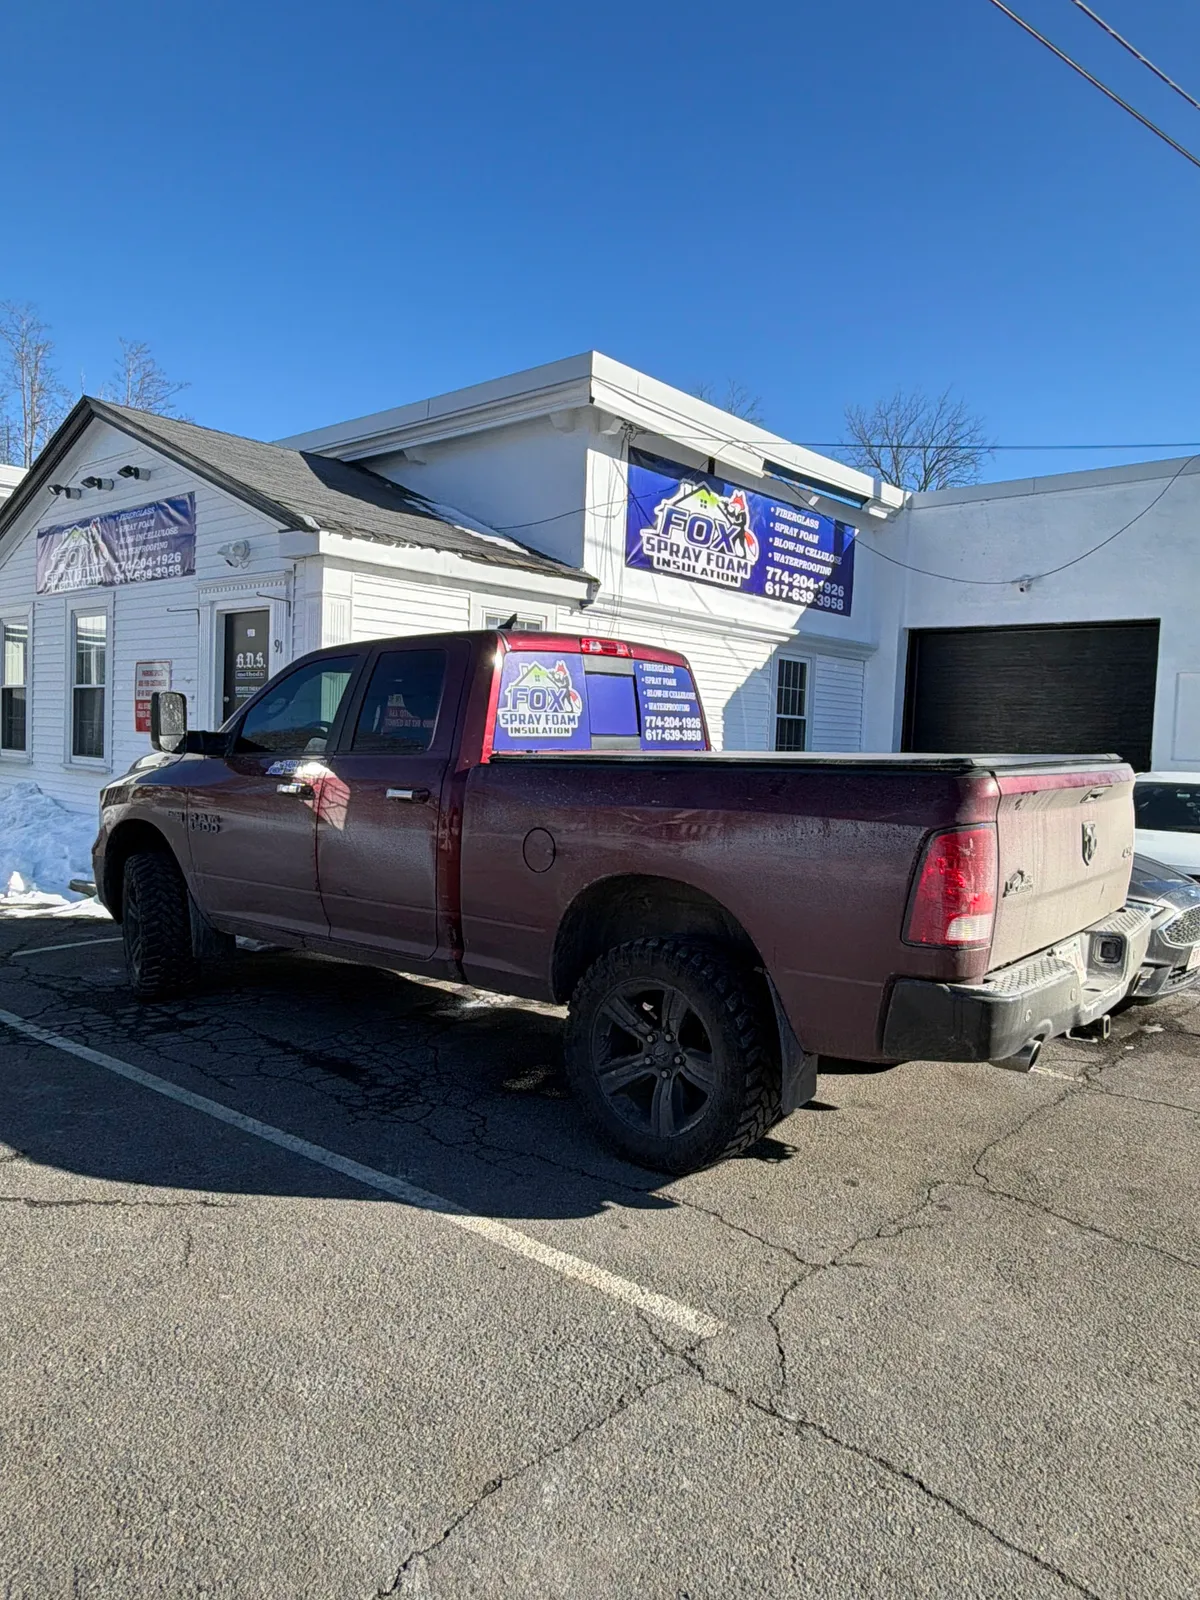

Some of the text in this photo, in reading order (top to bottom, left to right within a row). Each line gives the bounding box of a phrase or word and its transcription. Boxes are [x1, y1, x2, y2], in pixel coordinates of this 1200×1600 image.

[775, 507, 819, 529] FIBERGLASS
[660, 505, 741, 556] FOX
[774, 522, 819, 544] SPRAY FOAM
[645, 536, 749, 576] SPRAY FOAM
[773, 537, 842, 565] BLOW-IN CELLULOSE
[656, 557, 739, 584] INSULATION
[773, 552, 832, 576] WATERPROOFING
[766, 566, 844, 597] 774-204-1926
[765, 581, 844, 611] 617-639-3958
[274, 639, 283, 654] 91
[643, 663, 674, 674] FIBERGLASS
[645, 676, 677, 686] SPRAY FOAM
[511, 686, 567, 712] FOX
[648, 702, 690, 712] WATERPROOFING
[501, 713, 576, 725] SPRAY FOAM
[645, 716, 701, 728] 774-204-1926
